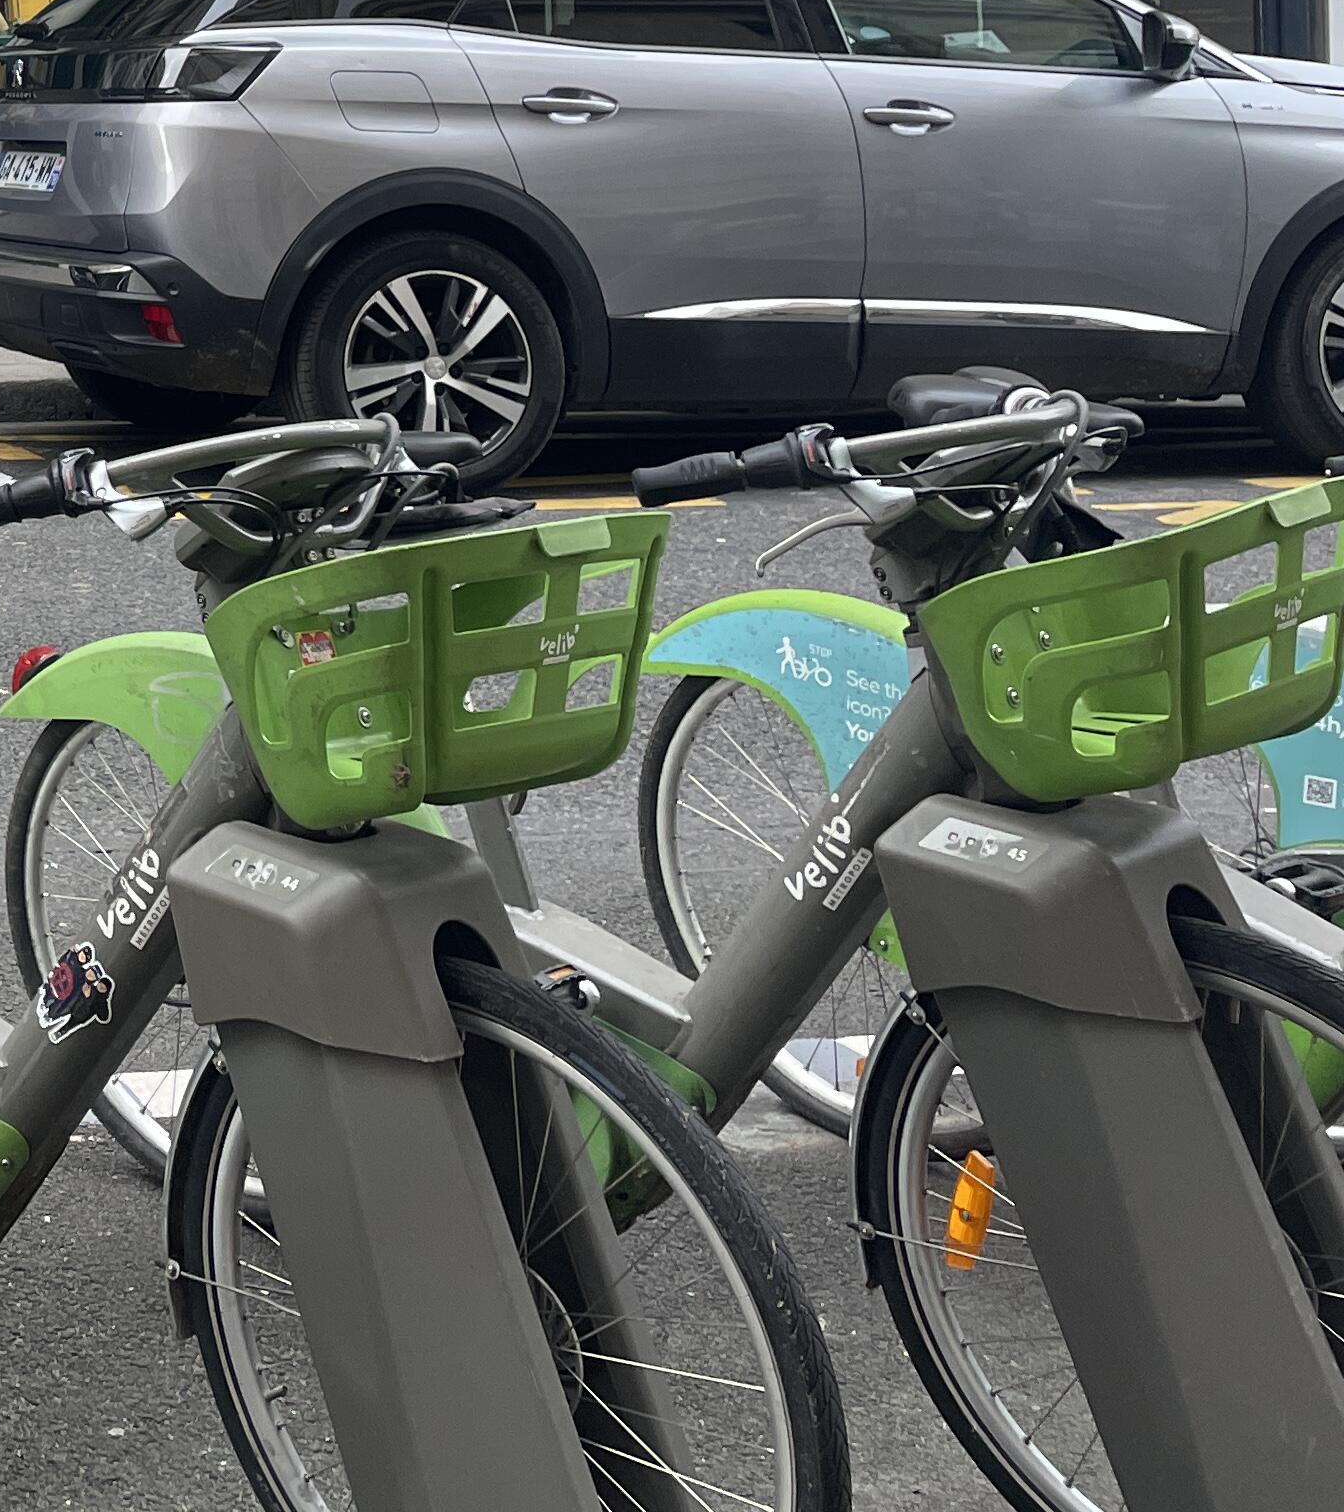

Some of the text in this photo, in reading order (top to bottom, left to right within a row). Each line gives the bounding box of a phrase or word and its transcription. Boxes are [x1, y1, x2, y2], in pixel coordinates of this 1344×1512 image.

[809, 643, 833, 658] STOP
[846, 669, 906, 701] See th
[846, 696, 892, 721] icon?
[1007, 847, 1028, 862] 45
[134, 891, 170, 947] MÉTROPO
